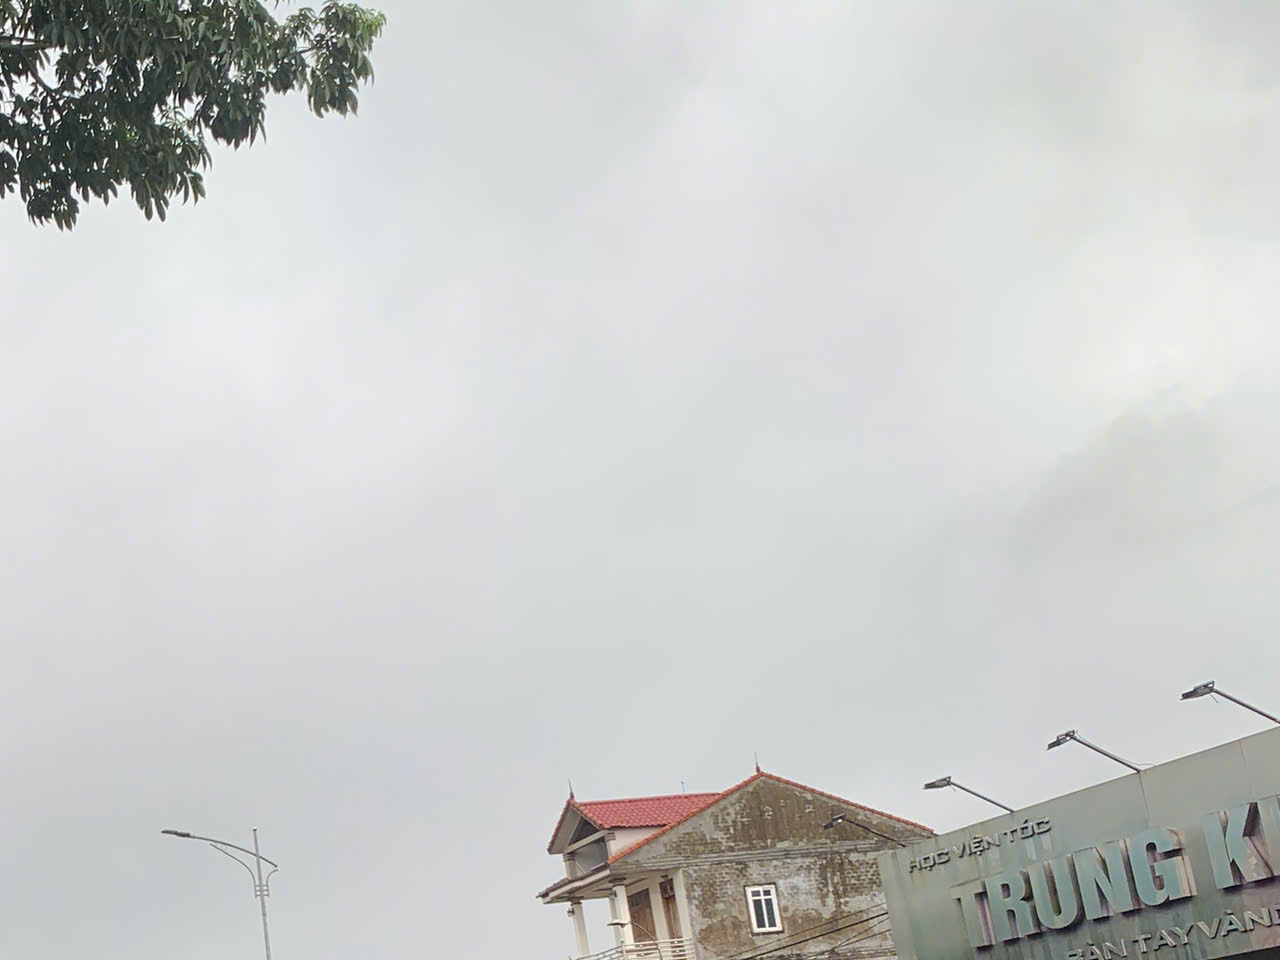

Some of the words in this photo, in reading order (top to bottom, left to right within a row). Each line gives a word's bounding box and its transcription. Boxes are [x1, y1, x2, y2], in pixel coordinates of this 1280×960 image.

[909, 848, 951, 874] HỌC
[954, 831, 1001, 857] VIỆN
[1003, 817, 1052, 843] TÓC
[950, 827, 1196, 951] TRUNG
[1133, 923, 1194, 953] TAY
